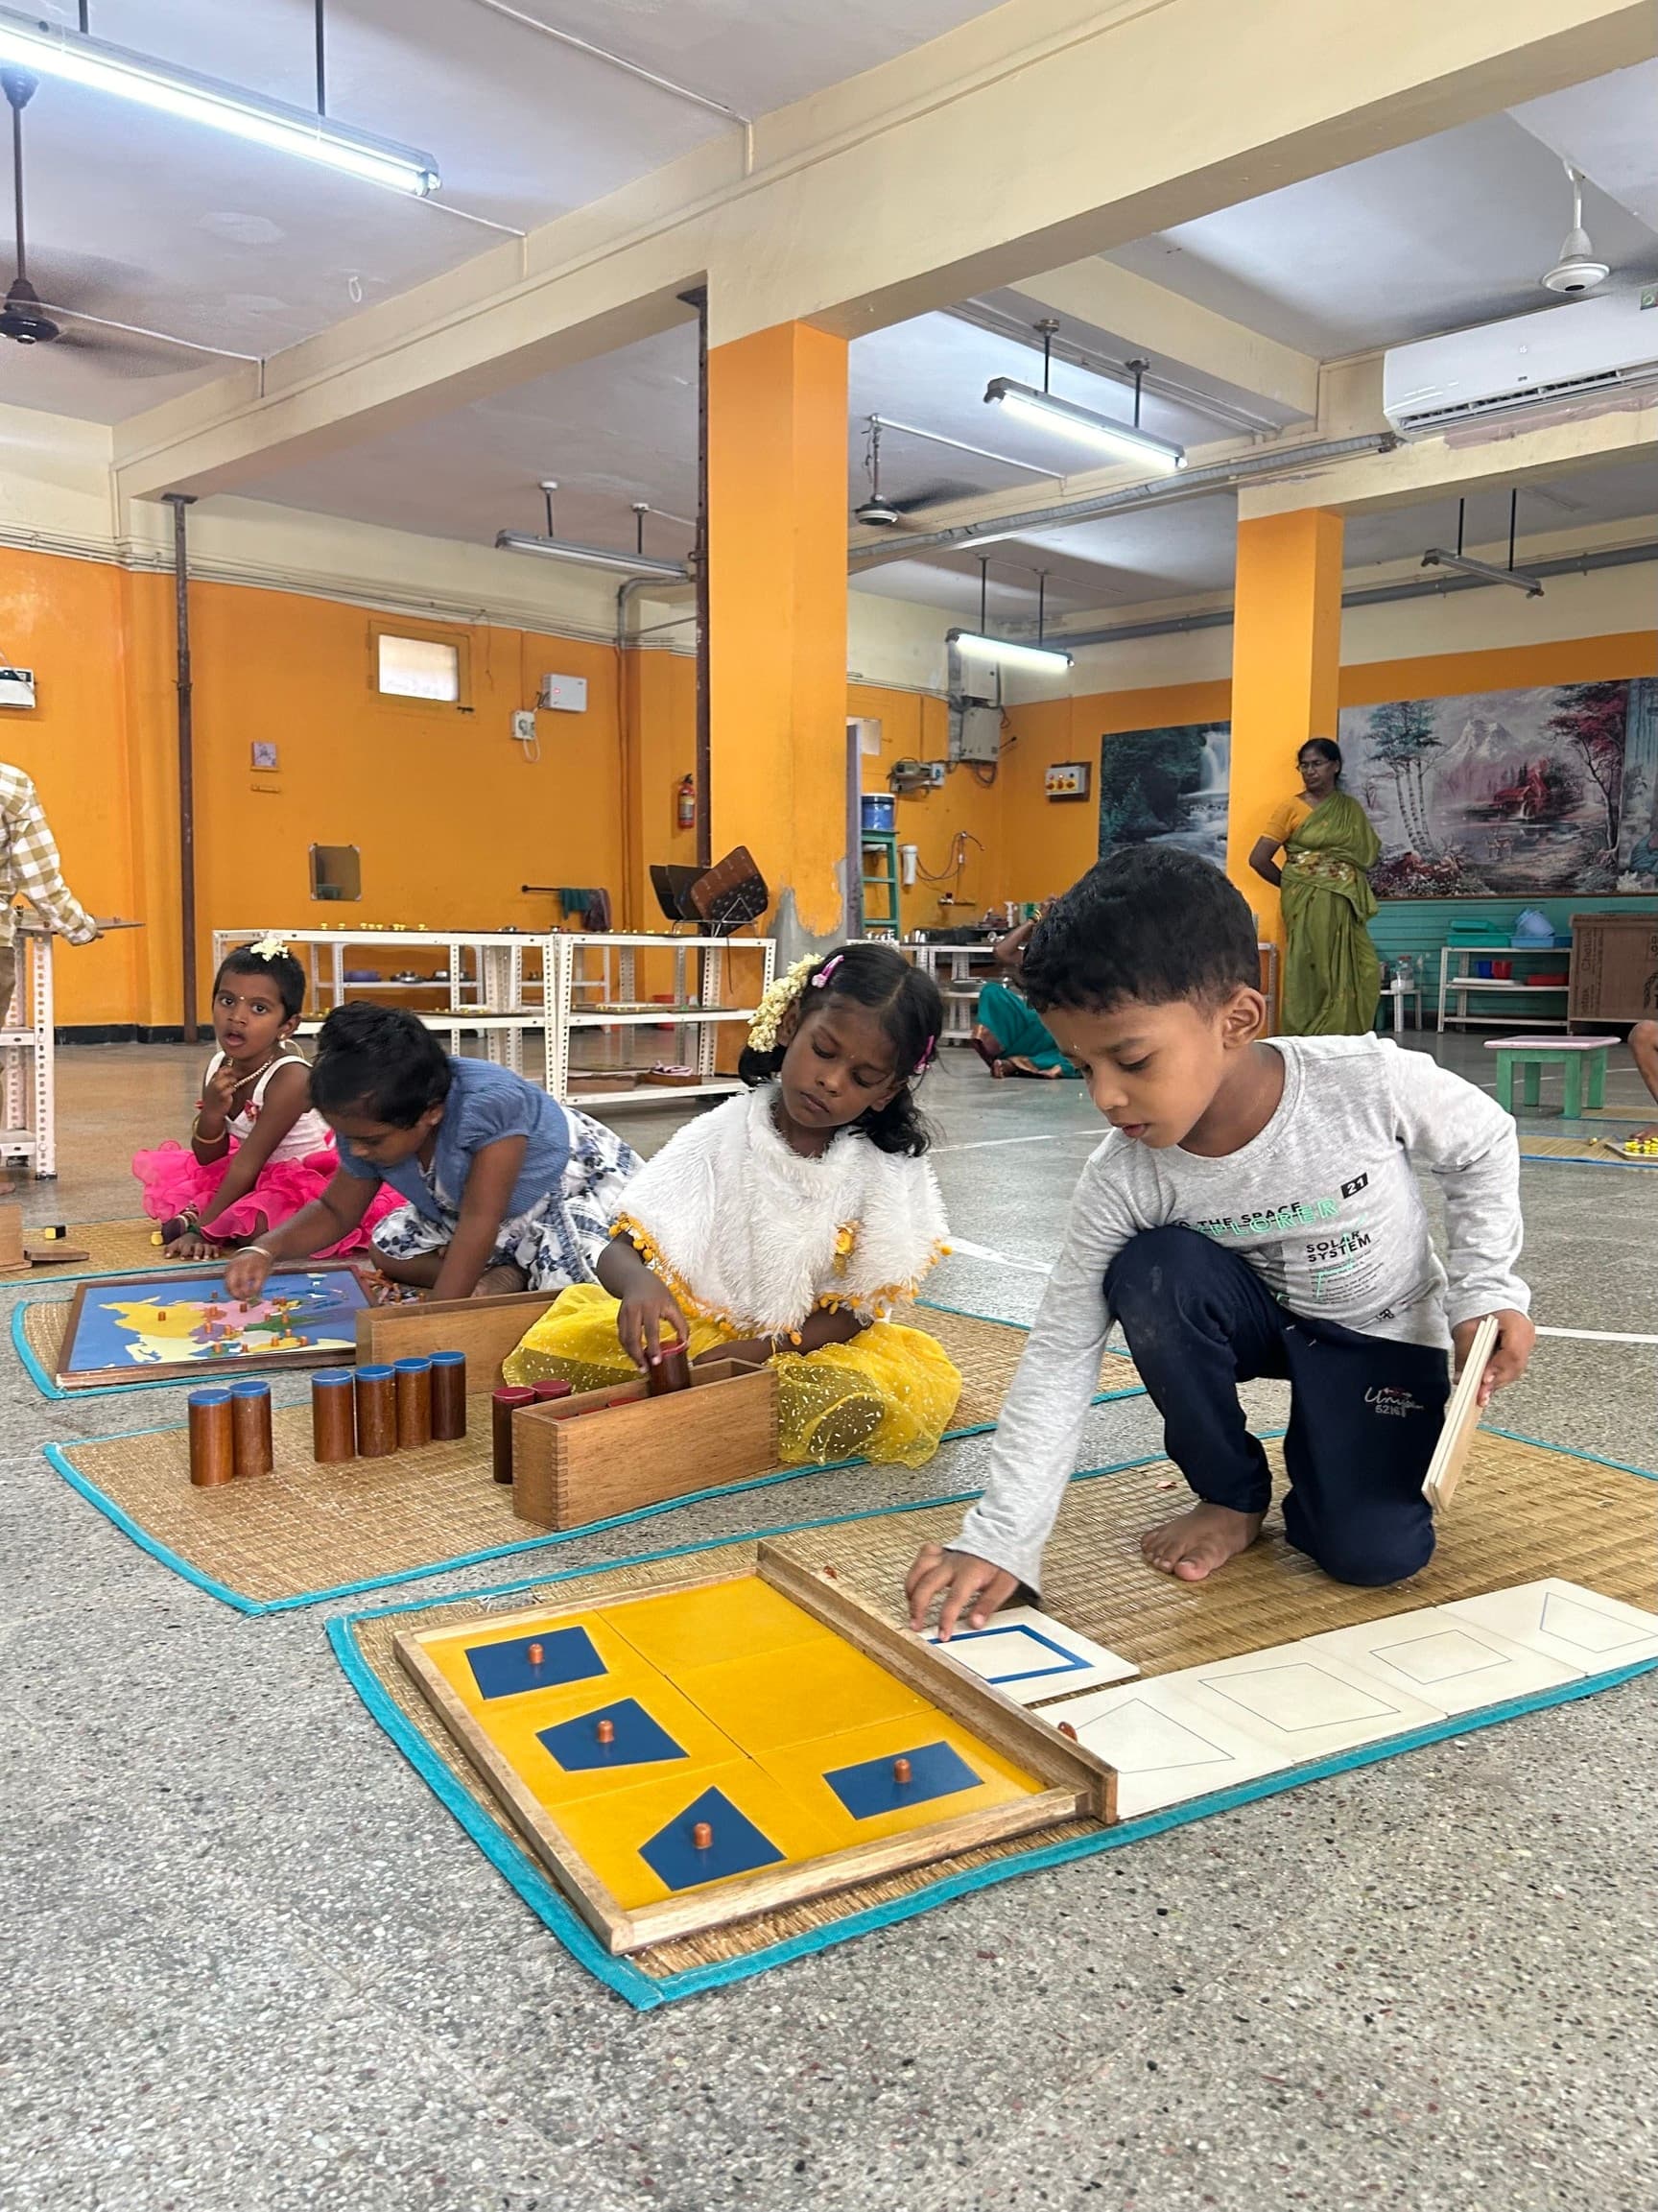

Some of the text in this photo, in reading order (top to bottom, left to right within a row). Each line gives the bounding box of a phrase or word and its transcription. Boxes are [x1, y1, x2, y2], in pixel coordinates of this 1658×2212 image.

[1347, 1177, 1367, 1193] 21
[1197, 1217, 1233, 1227] THE
[1241, 1201, 1303, 1226] SPACE
[1198, 1198, 1339, 1237] PLORER
[1306, 1230, 1360, 1253] SOLAR
[1308, 1233, 1371, 1263] SYSTEM
